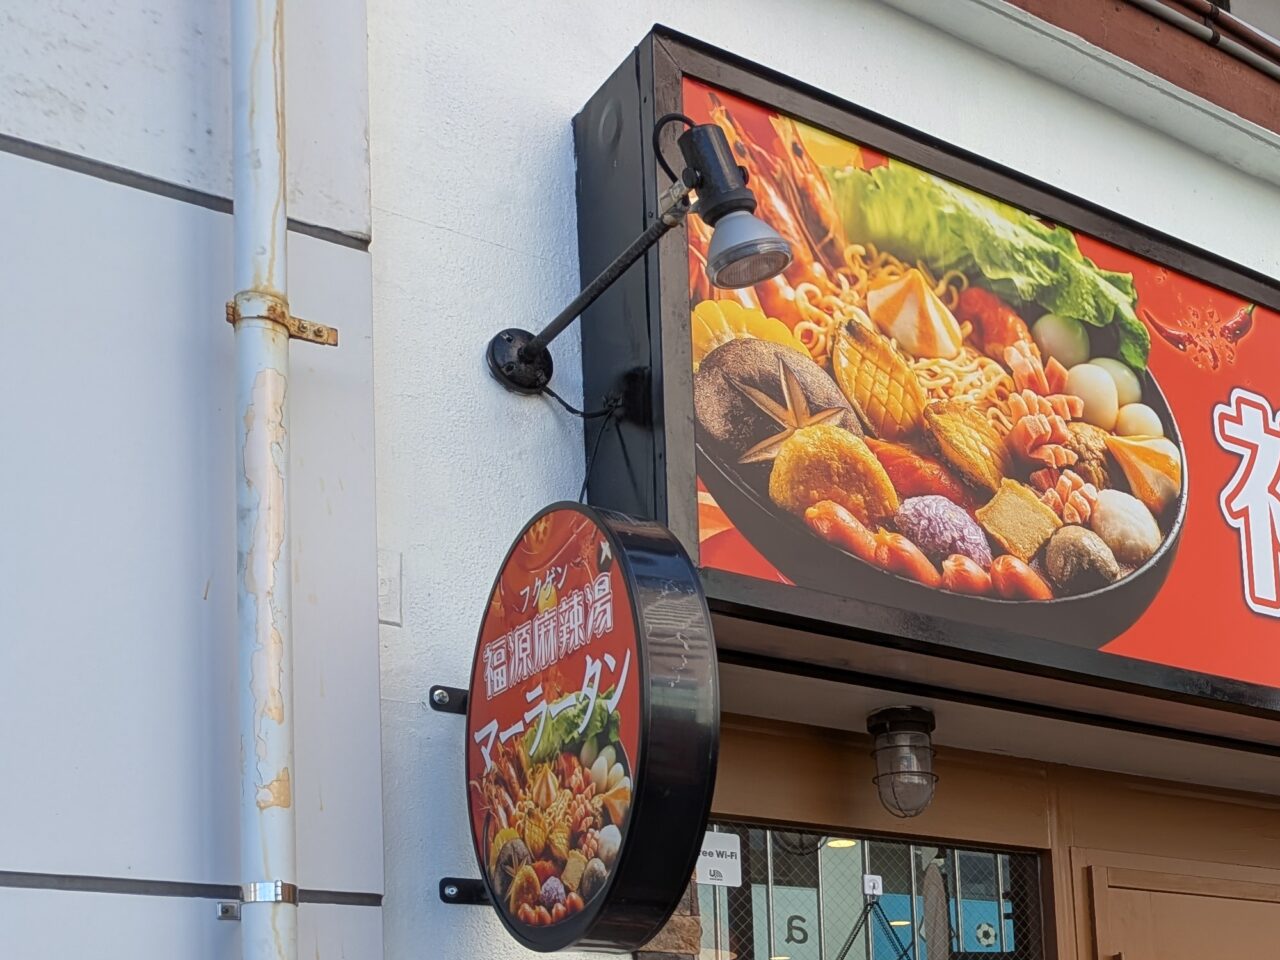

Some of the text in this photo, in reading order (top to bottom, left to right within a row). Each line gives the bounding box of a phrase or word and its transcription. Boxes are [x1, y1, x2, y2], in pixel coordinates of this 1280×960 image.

[520, 565, 568, 613] フクゲン
[483, 571, 613, 700] 福源麻辣湯
[474, 648, 630, 777] マーラータン
[716, 849, 738, 861] Wi-Fi
